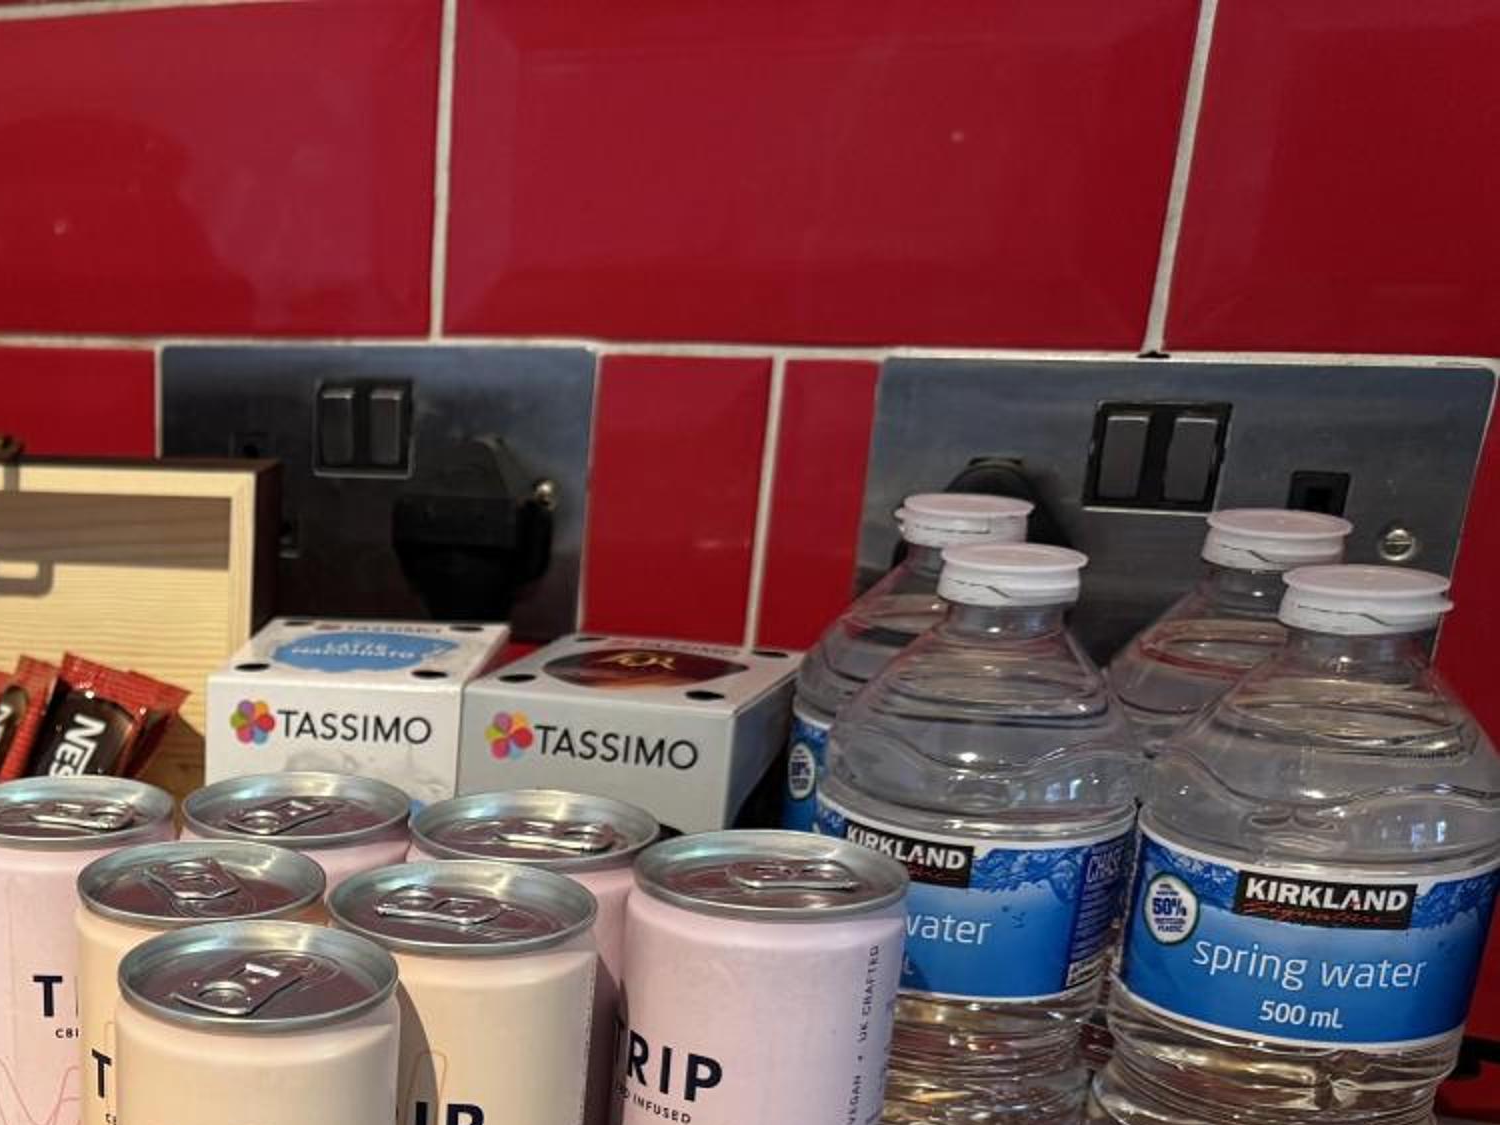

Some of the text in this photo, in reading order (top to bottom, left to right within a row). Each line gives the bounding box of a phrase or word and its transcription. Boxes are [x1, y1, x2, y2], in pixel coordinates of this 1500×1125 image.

[277, 708, 432, 745] TASSIMO
[534, 724, 699, 770] TASSIMO
[847, 825, 966, 869] KIRKLAND
[1245, 877, 1408, 911] KIRKLAND
[1192, 940, 1428, 991] spring water
[857, 1021, 869, 1043] UK
[1259, 1000, 1344, 1029] 500 mL
[632, 1093, 692, 1125] INFUSED
